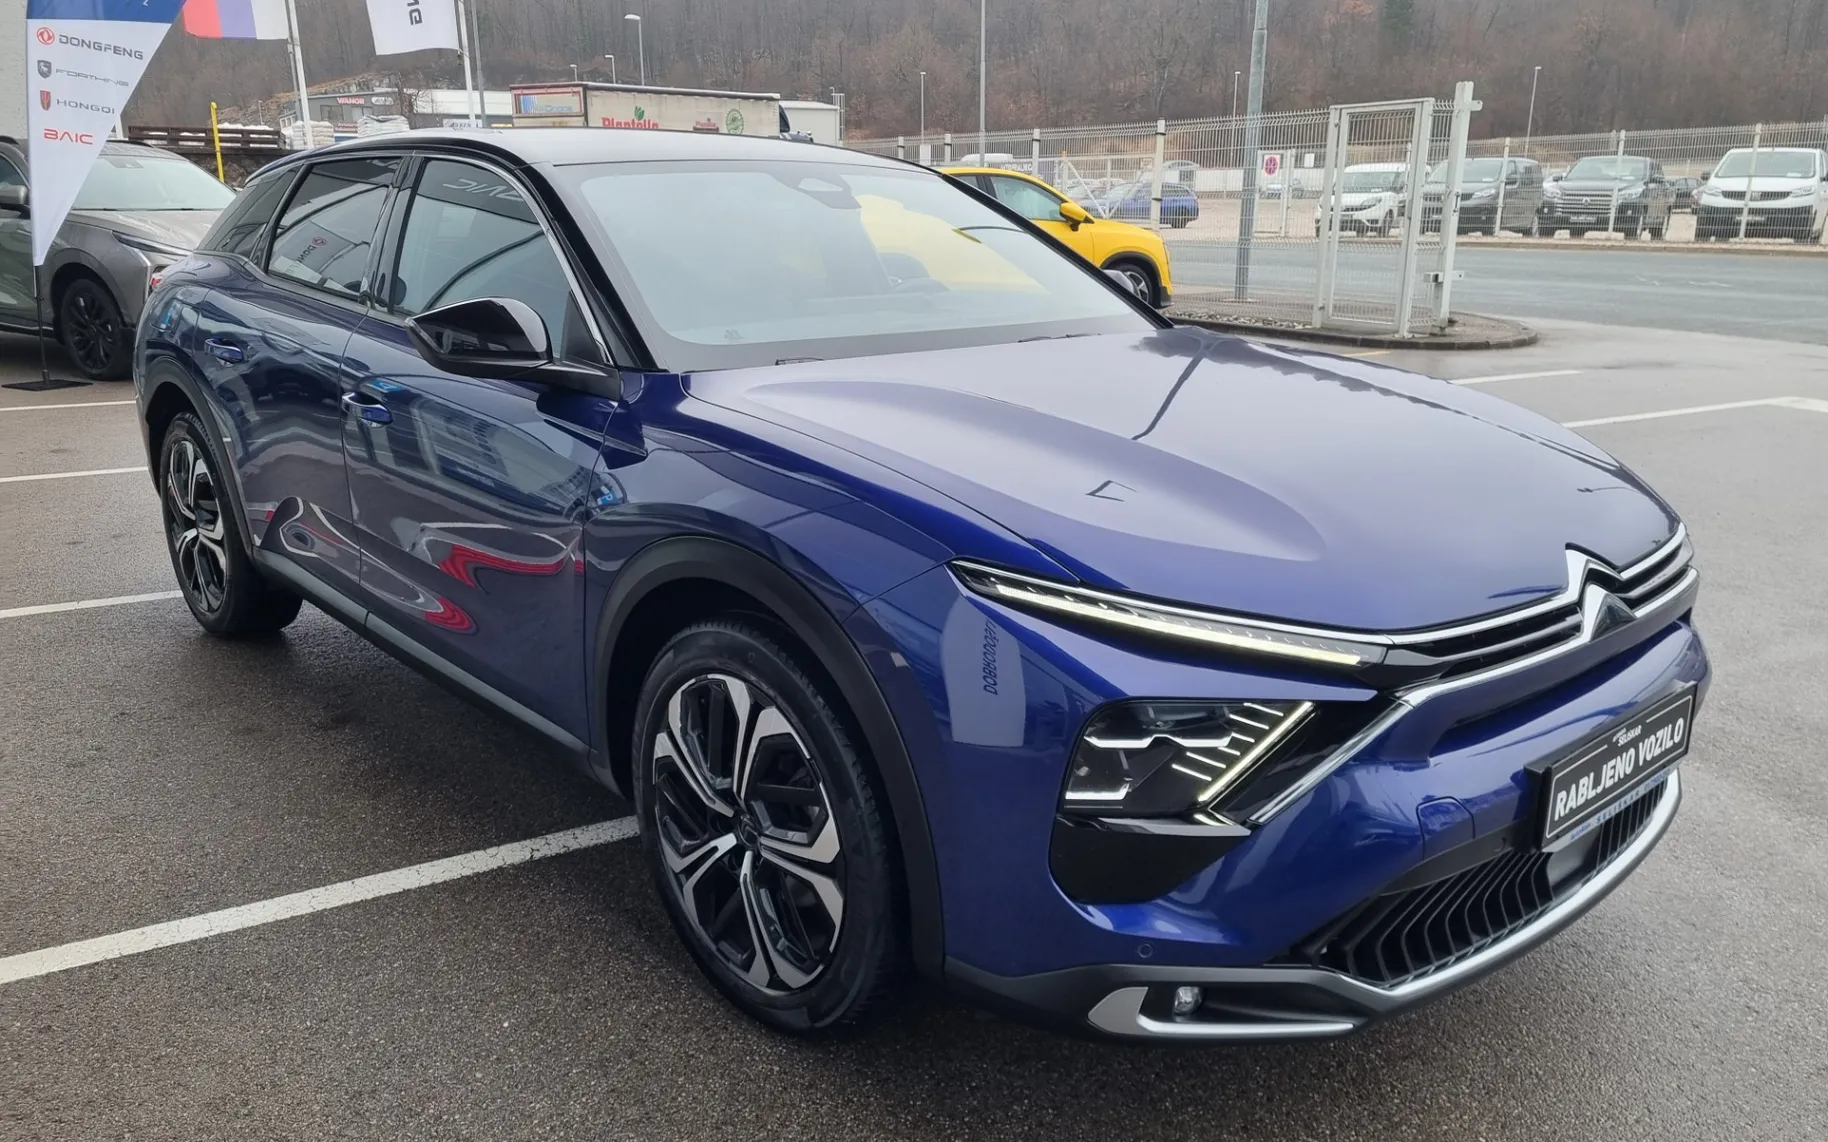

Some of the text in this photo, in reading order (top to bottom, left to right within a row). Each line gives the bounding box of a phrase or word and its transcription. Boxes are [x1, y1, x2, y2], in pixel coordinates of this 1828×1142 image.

[58, 34, 144, 60] DONGFENG
[55, 68, 130, 87] FORTHING
[56, 98, 115, 114] HONGQI
[43, 128, 93, 145] BAIC
[1553, 717, 1685, 822] RABLJENO VOZILO
